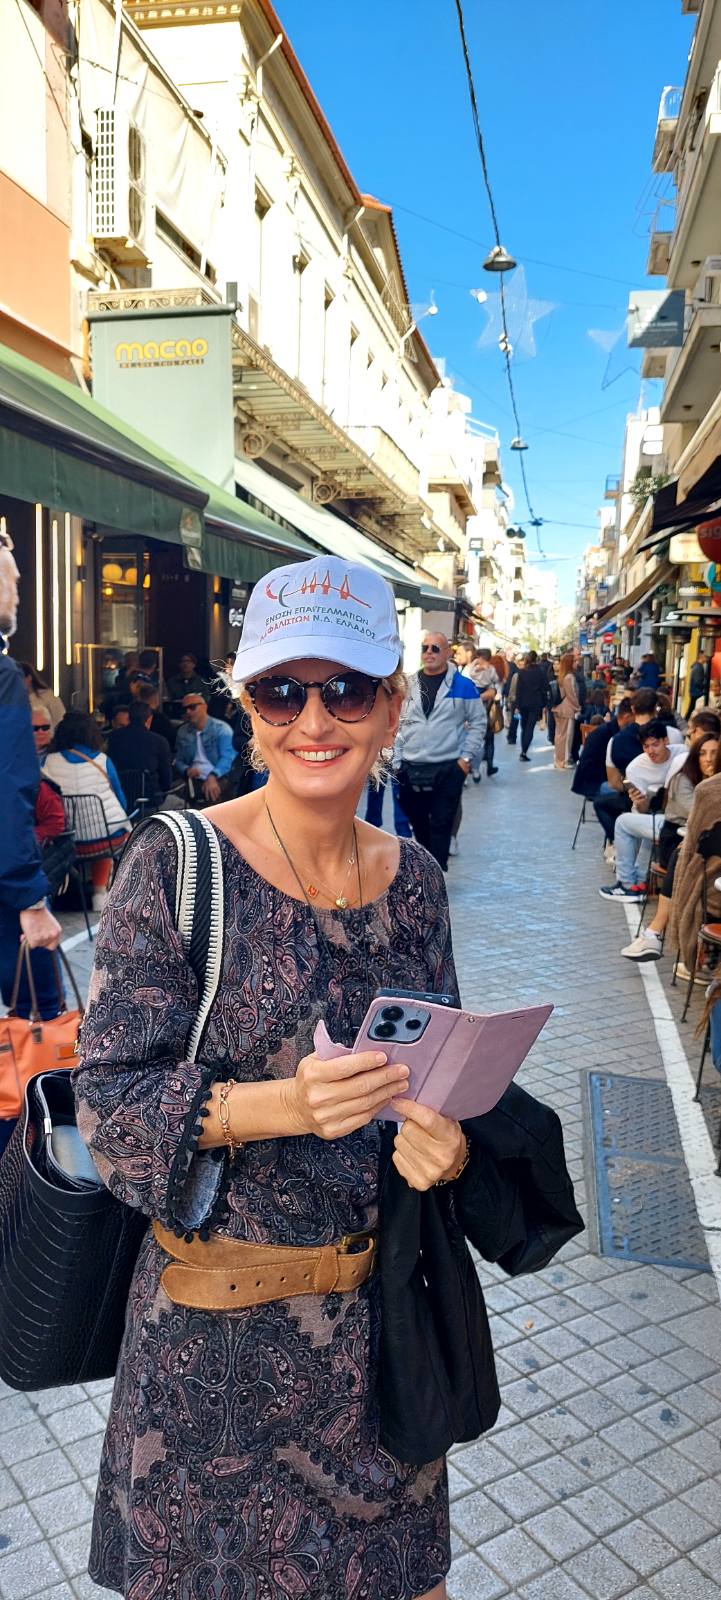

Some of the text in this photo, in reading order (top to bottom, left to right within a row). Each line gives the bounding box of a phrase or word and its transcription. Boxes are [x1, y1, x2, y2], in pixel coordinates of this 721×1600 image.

[115, 337, 208, 361] macao
[265, 609, 292, 626] ΕΝΩΣΗ
[336, 617, 376, 639] ΕΛΛΑΔΟΣ
